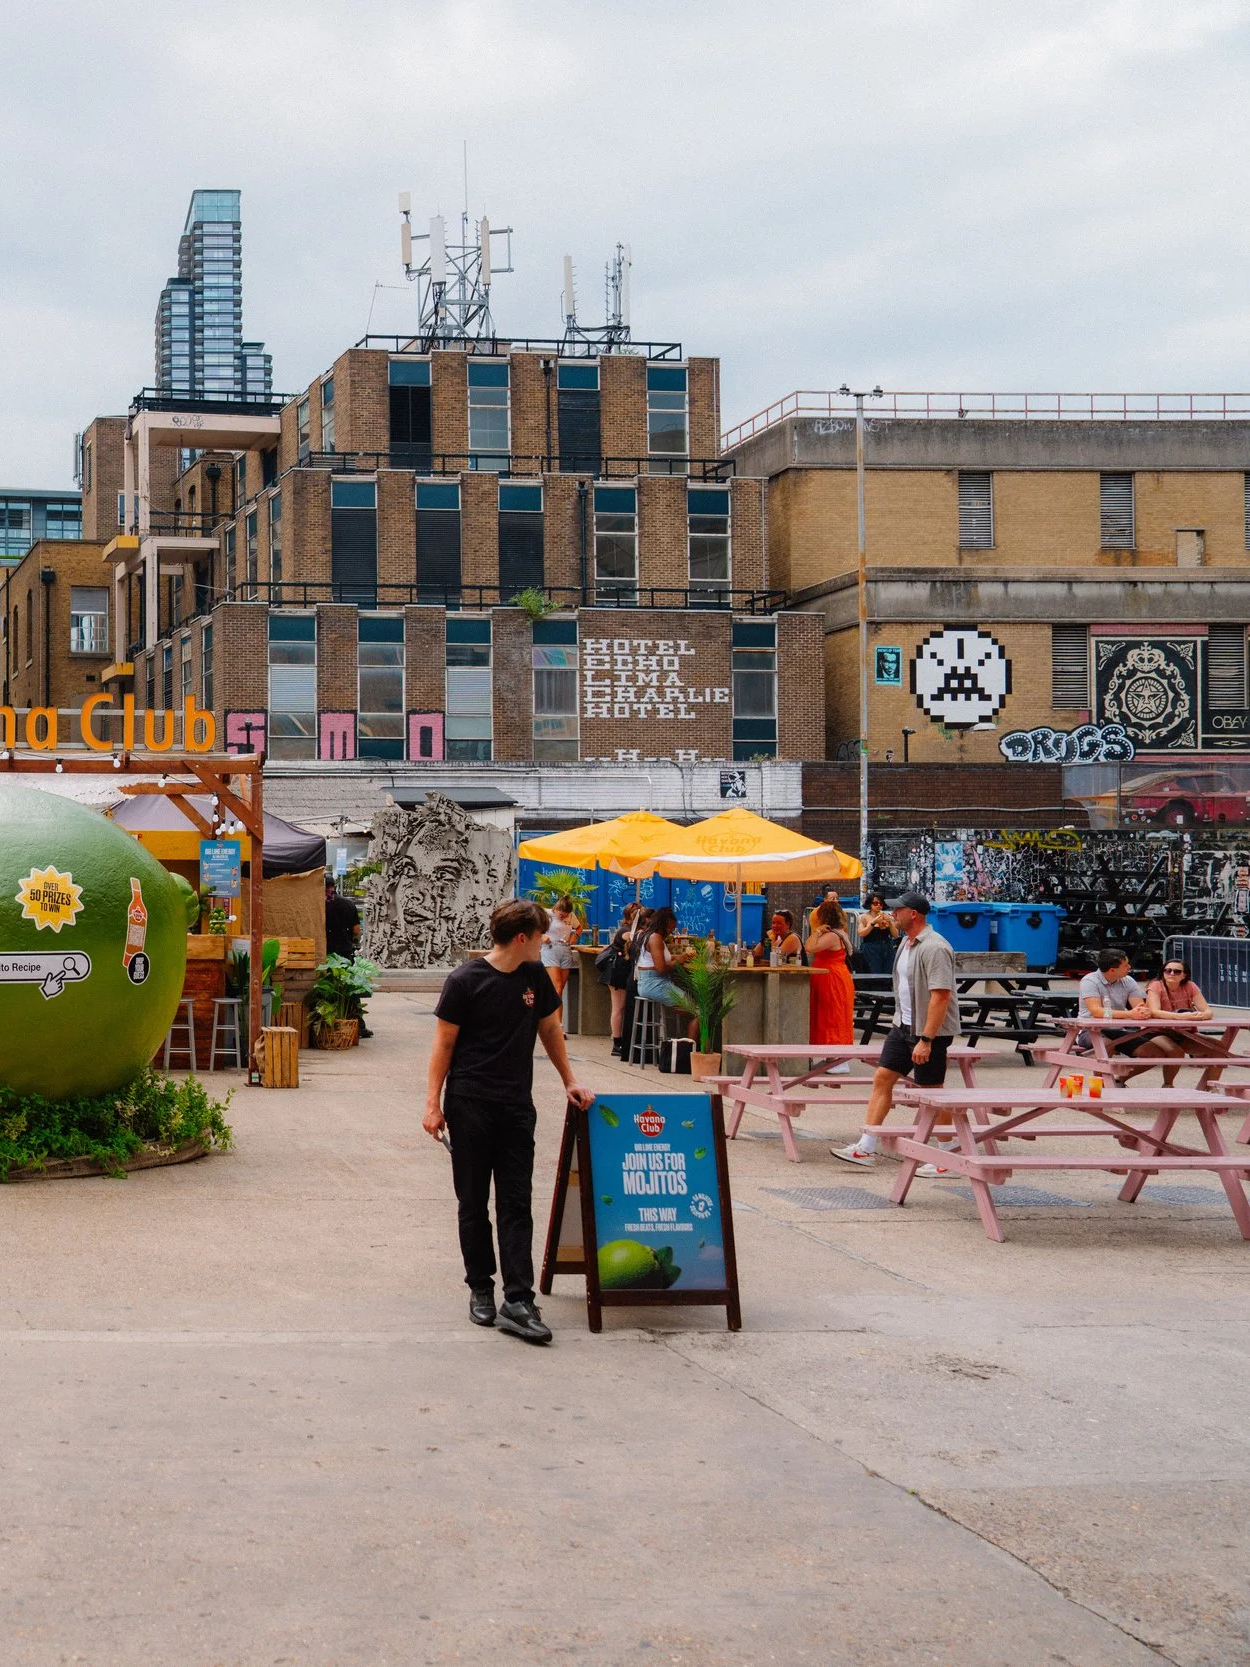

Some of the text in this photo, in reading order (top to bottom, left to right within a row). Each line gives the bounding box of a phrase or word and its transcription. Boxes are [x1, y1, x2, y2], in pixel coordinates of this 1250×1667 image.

[583, 639, 696, 655] HOTEL
[583, 655, 680, 670] ECHO
[583, 671, 685, 686] LIMA
[583, 687, 730, 703] CHARLIE
[583, 703, 696, 719] HOTEL
[80, 693, 217, 751] Club
[1212, 716, 1248, 729] OBEY
[1000, 723, 1135, 762] DRUGS
[695, 835, 762, 845] Havana
[44, 882, 59, 891] OVER
[30, 889, 71, 906] 50 PRIZES
[40, 902, 61, 913] TO WIN
[12, 963, 41, 973] Recipe
[634, 1114, 666, 1124] Havana
[641, 1123, 660, 1132] Club
[622, 1153, 686, 1170] JOIN US FOR
[623, 1171, 688, 1195] MOJITOS
[638, 1208, 658, 1221] THIS
[659, 1208, 677, 1221] WAY
